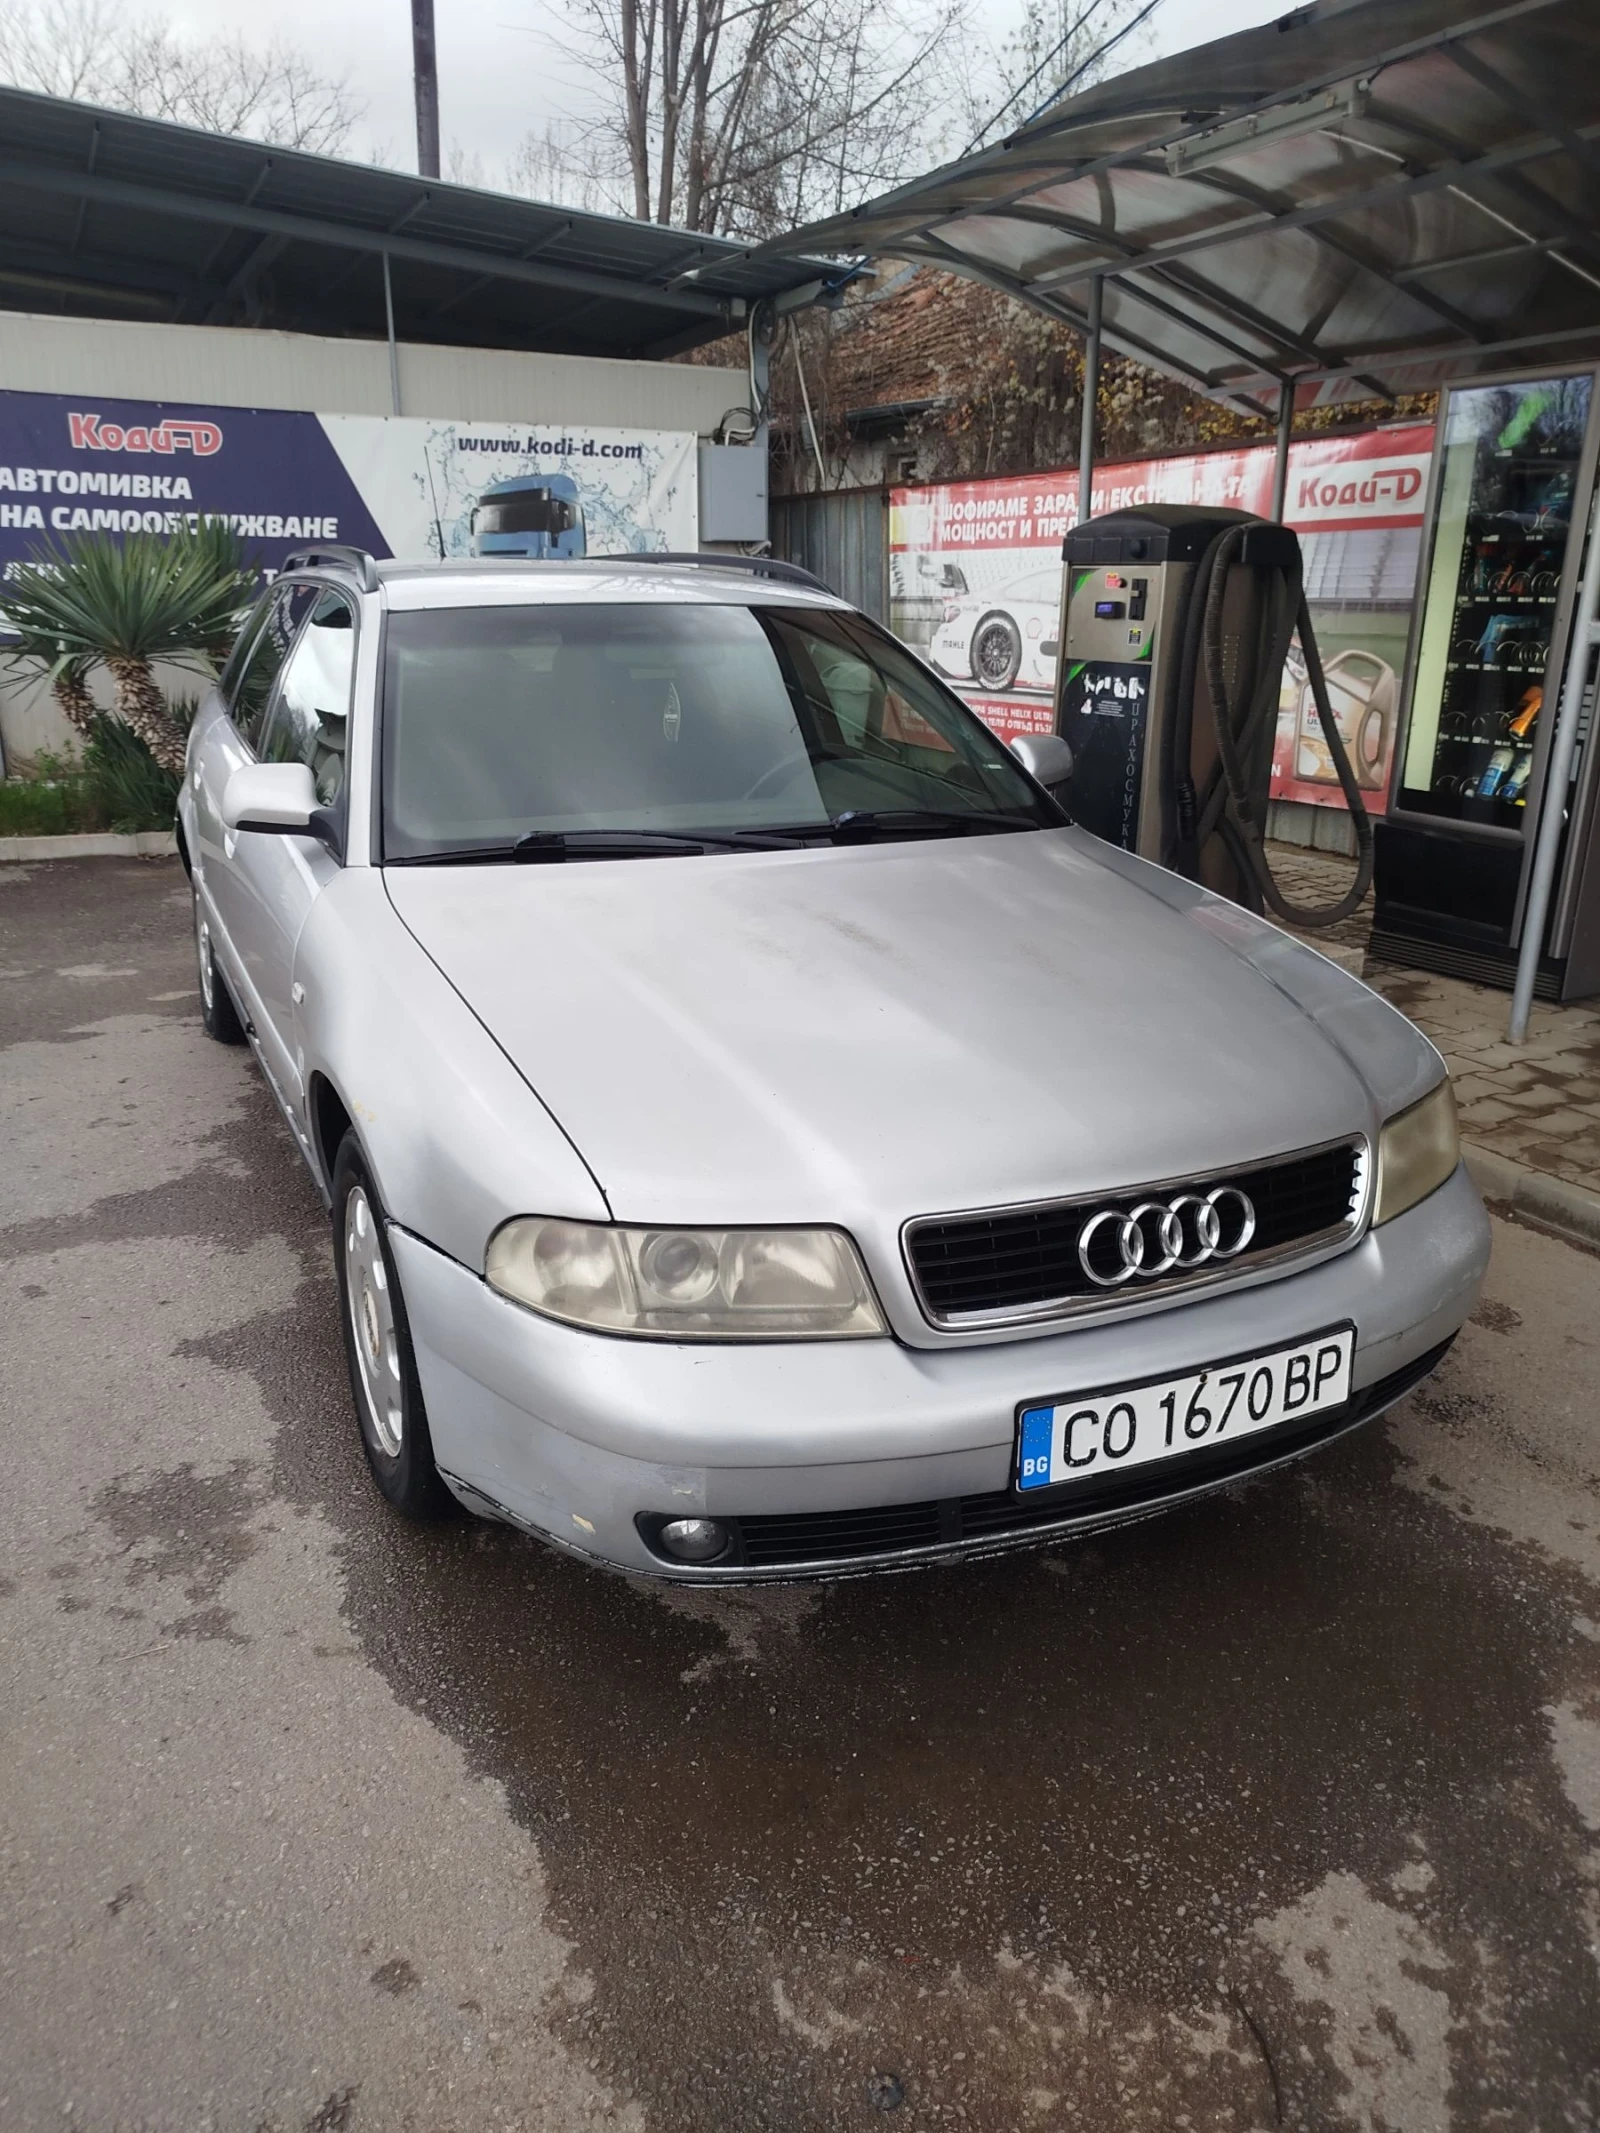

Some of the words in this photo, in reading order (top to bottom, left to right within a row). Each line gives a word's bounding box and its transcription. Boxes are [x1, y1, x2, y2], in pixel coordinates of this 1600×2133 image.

[458, 436, 643, 459] www.kodi-d.com
[0, 467, 193, 500] АВТОМИВКА
[0, 504, 46, 529] НА
[940, 496, 1028, 522] ШОФИРАМЕ
[940, 520, 1017, 545] МОЩНОСТ
[1020, 519, 1032, 539] И
[987, 705, 1009, 717] SHELL
[1010, 707, 1032, 720] HELIX
[1062, 1401, 1136, 1468] CO
[1158, 1366, 1273, 1448] 1670
[1282, 1343, 1343, 1413] BP
[1023, 1455, 1049, 1477] BG
